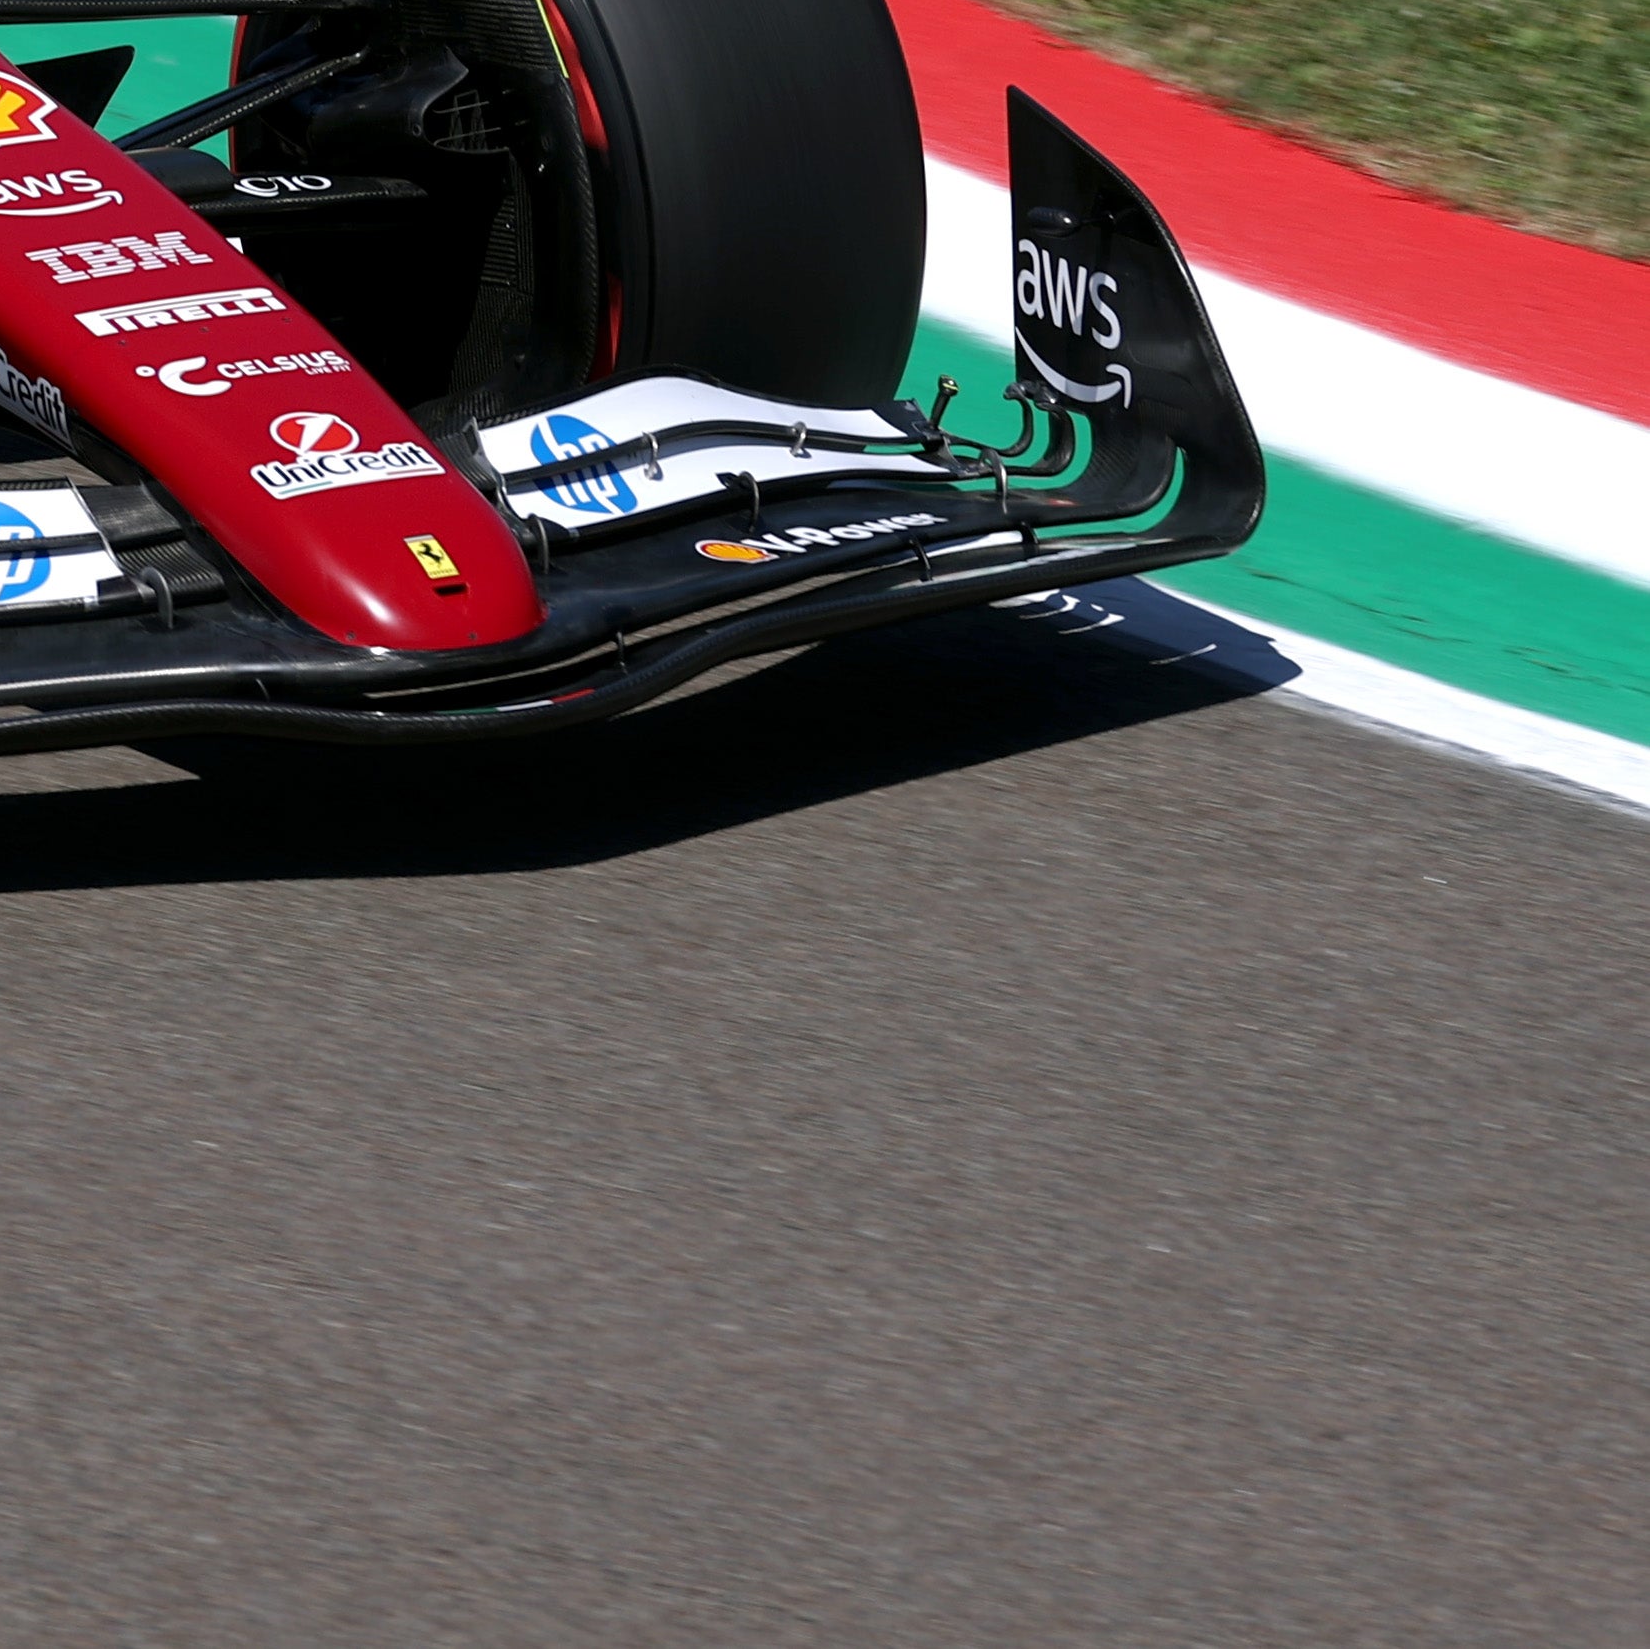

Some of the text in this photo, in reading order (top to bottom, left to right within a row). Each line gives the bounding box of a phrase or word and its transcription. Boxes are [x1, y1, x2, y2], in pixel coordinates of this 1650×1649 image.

[25, 231, 213, 285] IBM
[73, 287, 288, 337] PIRELLI
[1016, 239, 1122, 349] aws
[254, 444, 436, 488] UniCredit
[754, 512, 949, 556] V-Power
